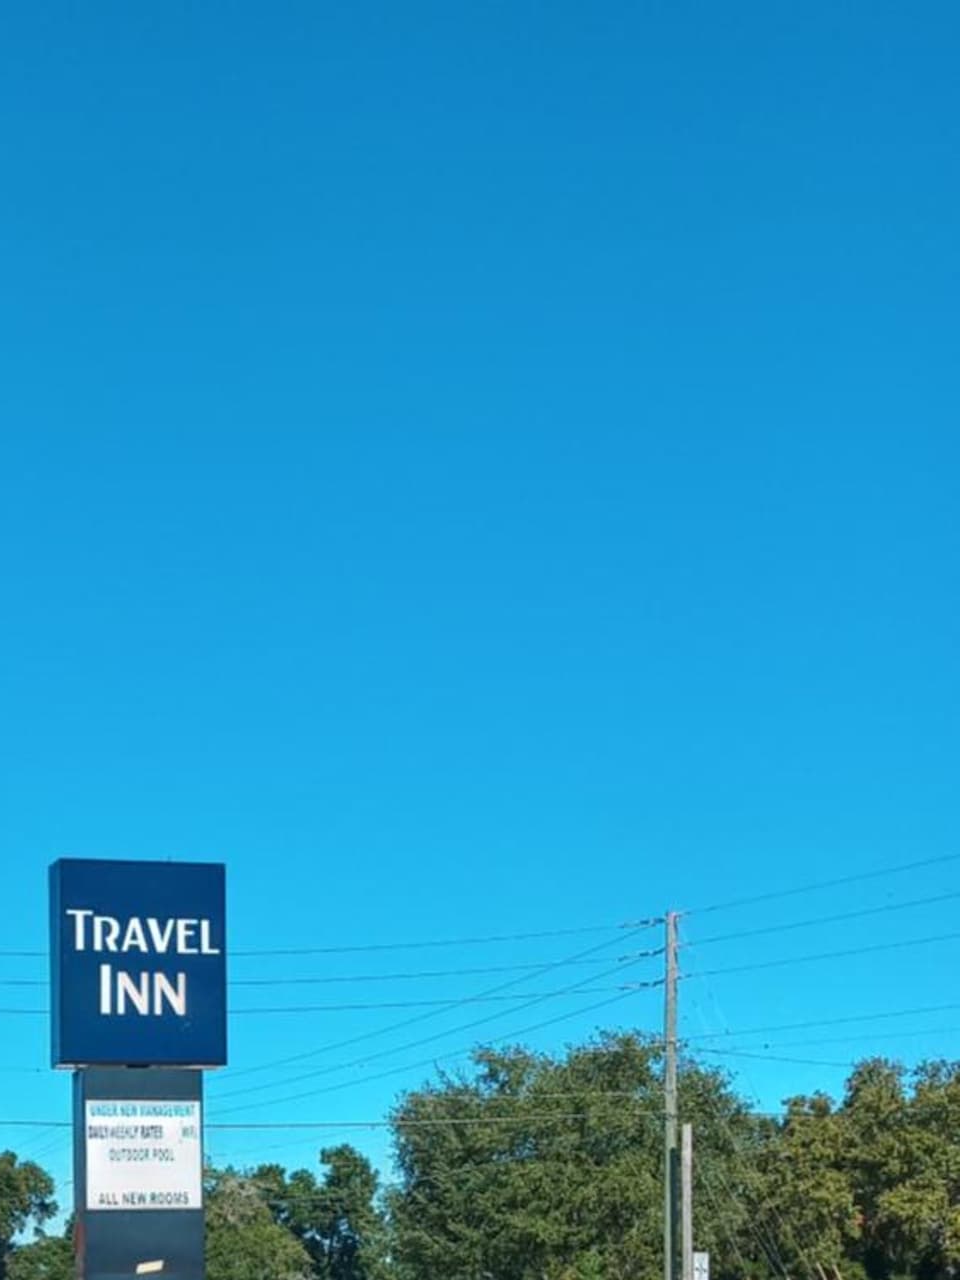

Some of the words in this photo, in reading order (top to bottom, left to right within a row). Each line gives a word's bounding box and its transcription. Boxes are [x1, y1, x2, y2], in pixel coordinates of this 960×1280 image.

[66, 909, 220, 954] TRAVEL
[100, 964, 186, 1016] INN
[90, 1103, 118, 1117] UNDER
[120, 1103, 138, 1118] NEW
[140, 1103, 196, 1118] MANAGEMENT
[109, 1147, 150, 1162] OUTDOOR
[152, 1147, 175, 1162] POOL
[98, 1192, 119, 1205] ALL
[121, 1191, 146, 1205] NEW
[149, 1191, 190, 1205] ROOMS
